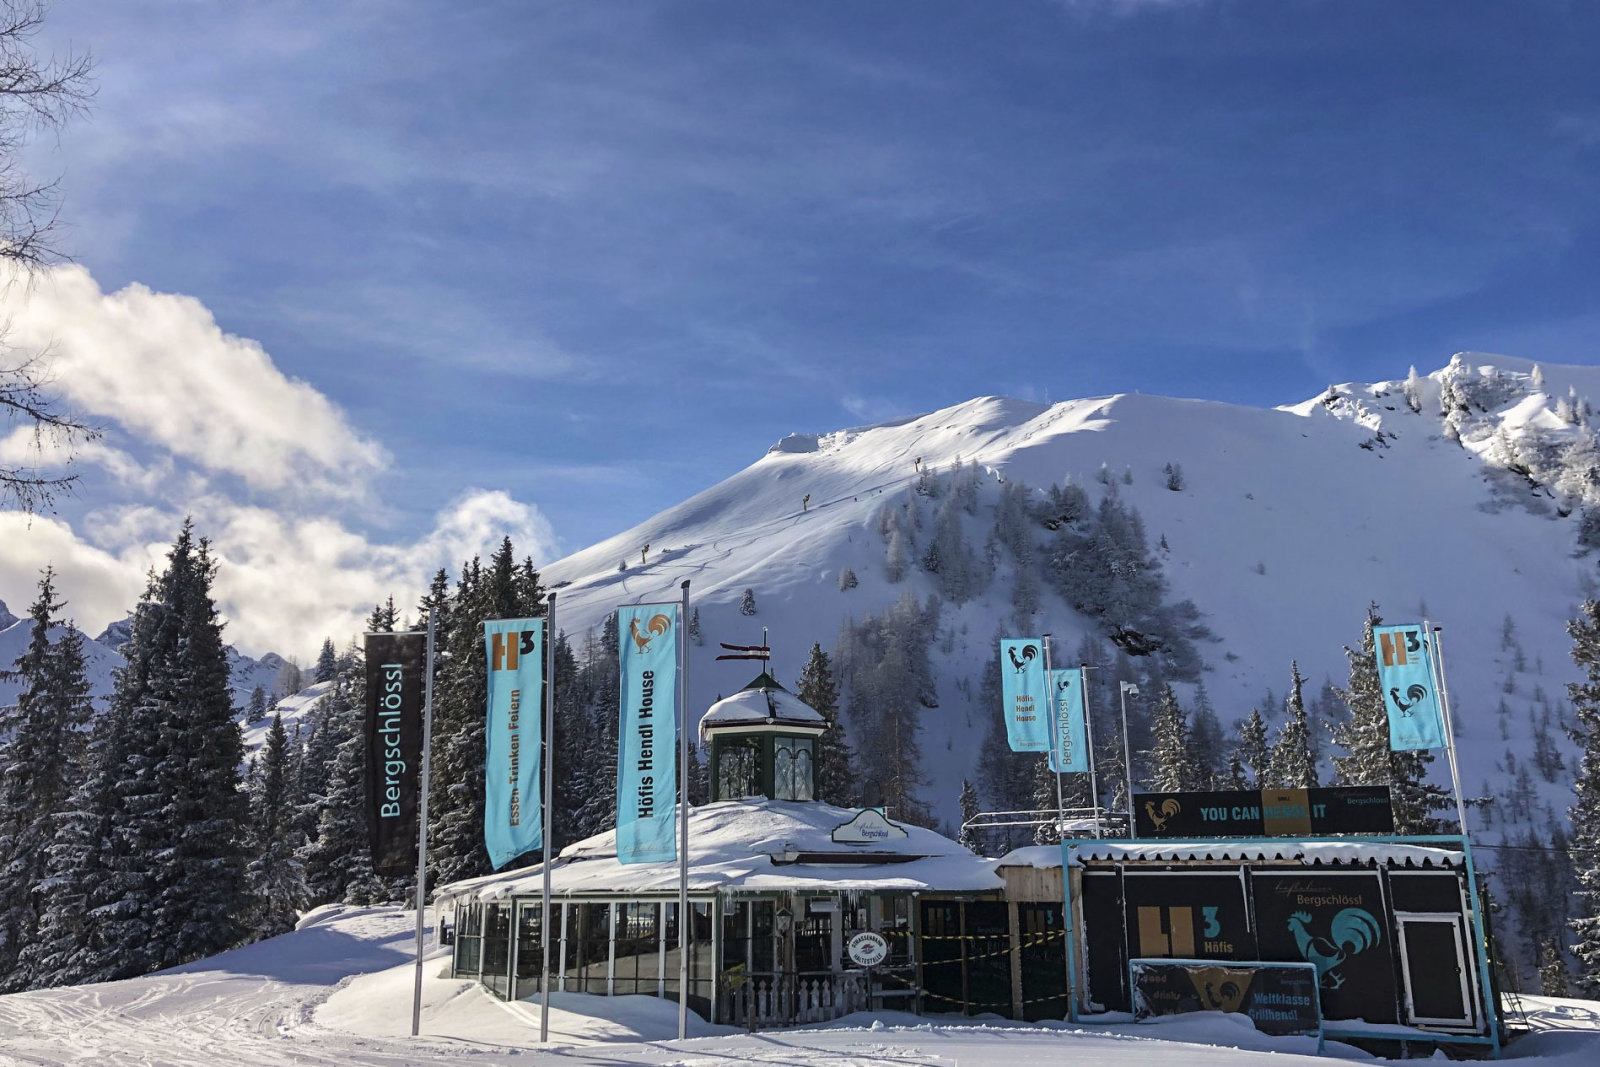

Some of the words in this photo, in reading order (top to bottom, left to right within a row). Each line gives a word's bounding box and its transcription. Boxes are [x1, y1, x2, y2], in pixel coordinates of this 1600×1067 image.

[508, 689, 521, 732] Feiern
[638, 670, 654, 718] House
[379, 663, 406, 818] Bergschlössl
[509, 733, 520, 784] Trinken
[638, 724, 654, 770] Hendl
[509, 785, 520, 827] Essen
[638, 775, 654, 818] Höfis
[1200, 807, 1228, 822] YOU
[1232, 806, 1261, 821] CAN
[1313, 803, 1327, 819] IT
[1297, 894, 1362, 906] Bergschlössl
[1204, 941, 1234, 953] Höfis
[1254, 992, 1310, 1006] Weltklasse
